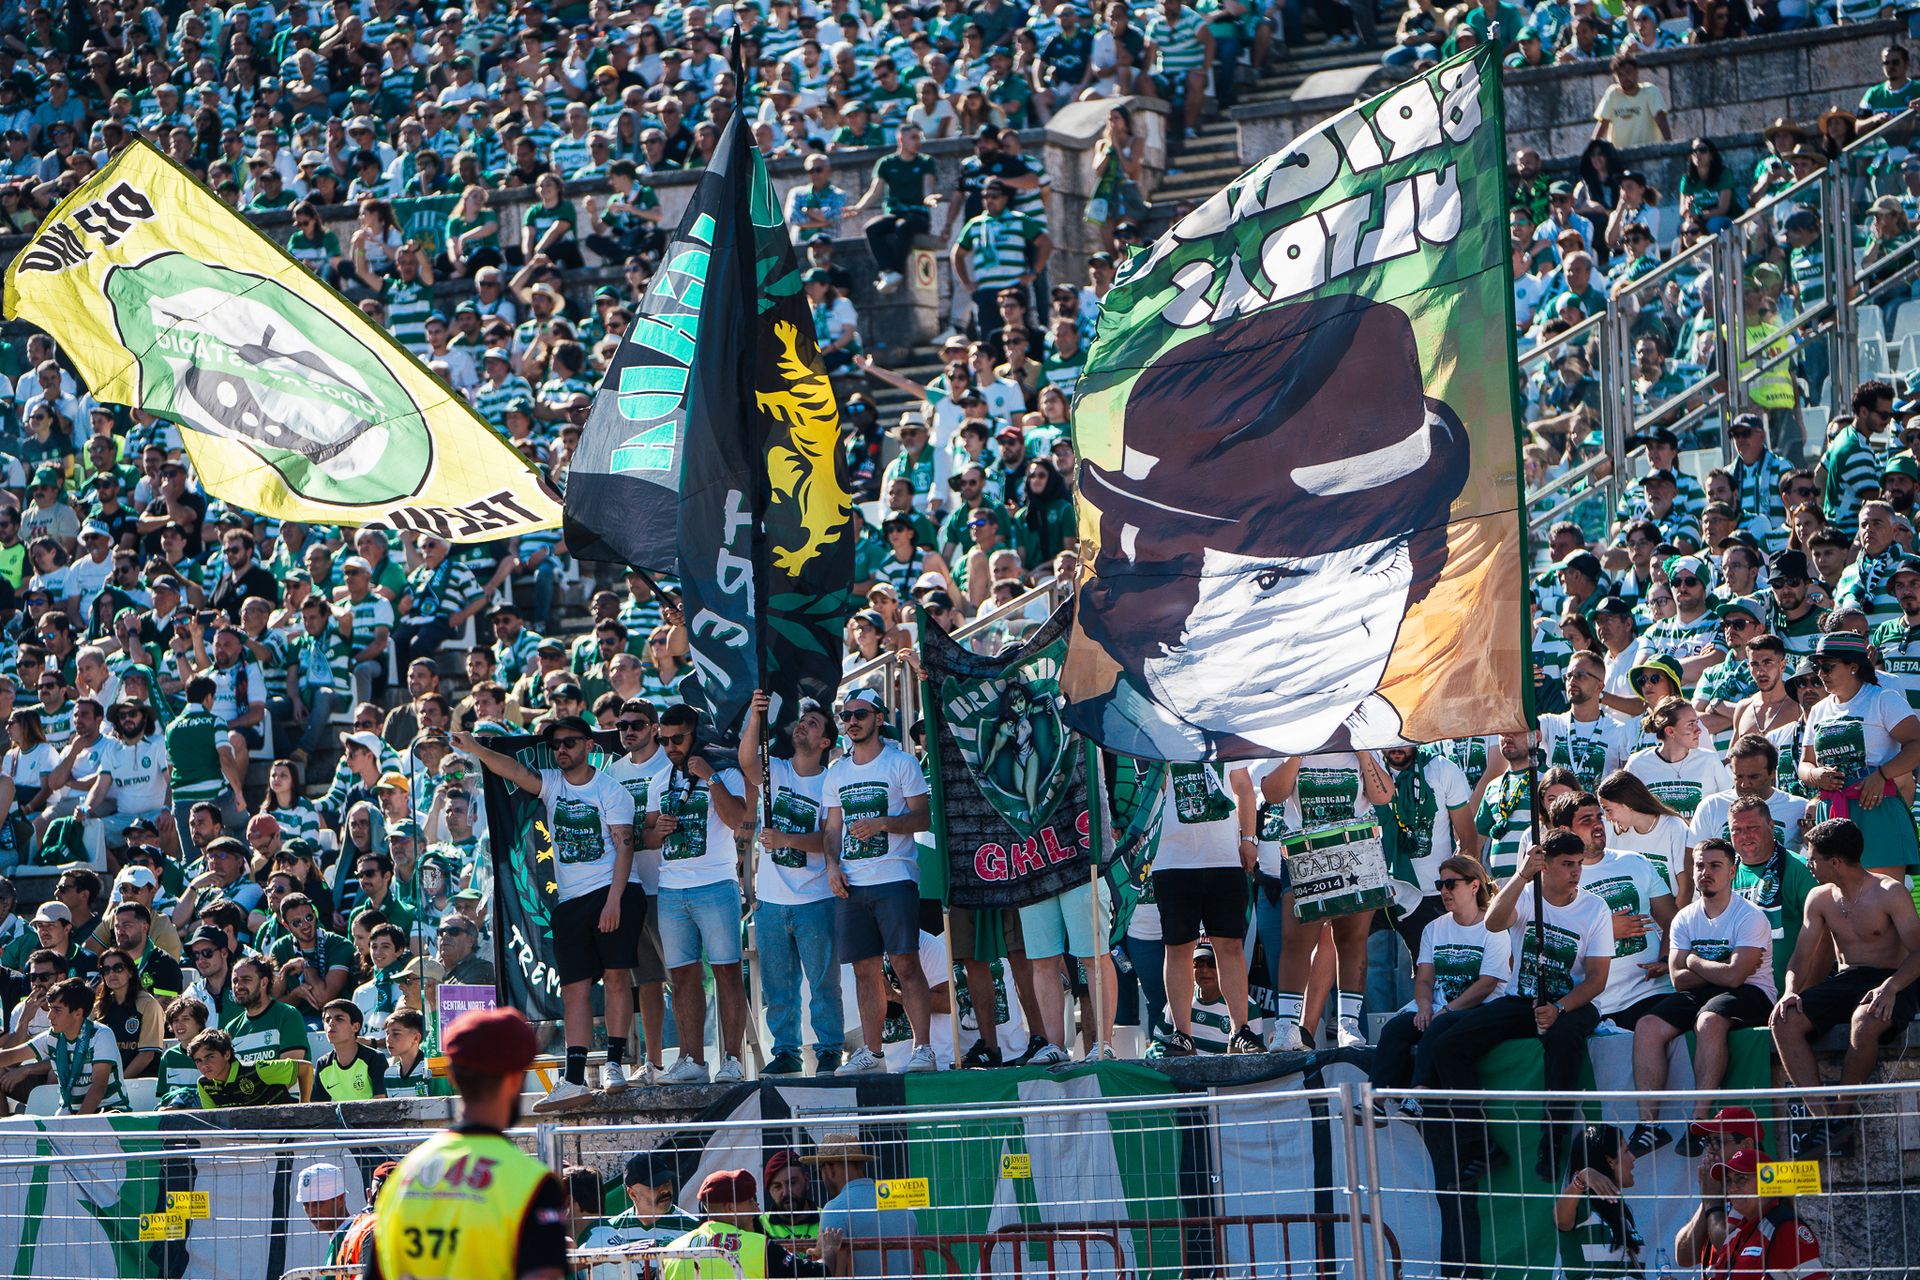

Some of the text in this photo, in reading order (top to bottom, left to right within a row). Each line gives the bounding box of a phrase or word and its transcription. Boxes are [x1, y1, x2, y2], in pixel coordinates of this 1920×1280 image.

[1784, 652, 1801, 665] BET
[1892, 660, 1920, 672] BETA
[948, 657, 1063, 722] BRIAD
[123, 775, 150, 786] BETANO
[1315, 794, 1351, 804] BRIGADA
[508, 923, 562, 998] TREM
[442, 1000, 486, 1011] CENTRAL NORTE
[243, 1049, 276, 1063] BETANO
[1790, 1103, 1807, 1119] 31
[1776, 1163, 1816, 1175] JOVEDA
[890, 1180, 926, 1190] JOVEDA
[175, 1193, 206, 1203] JOVEDA
[150, 1214, 183, 1225] JOVEDA
